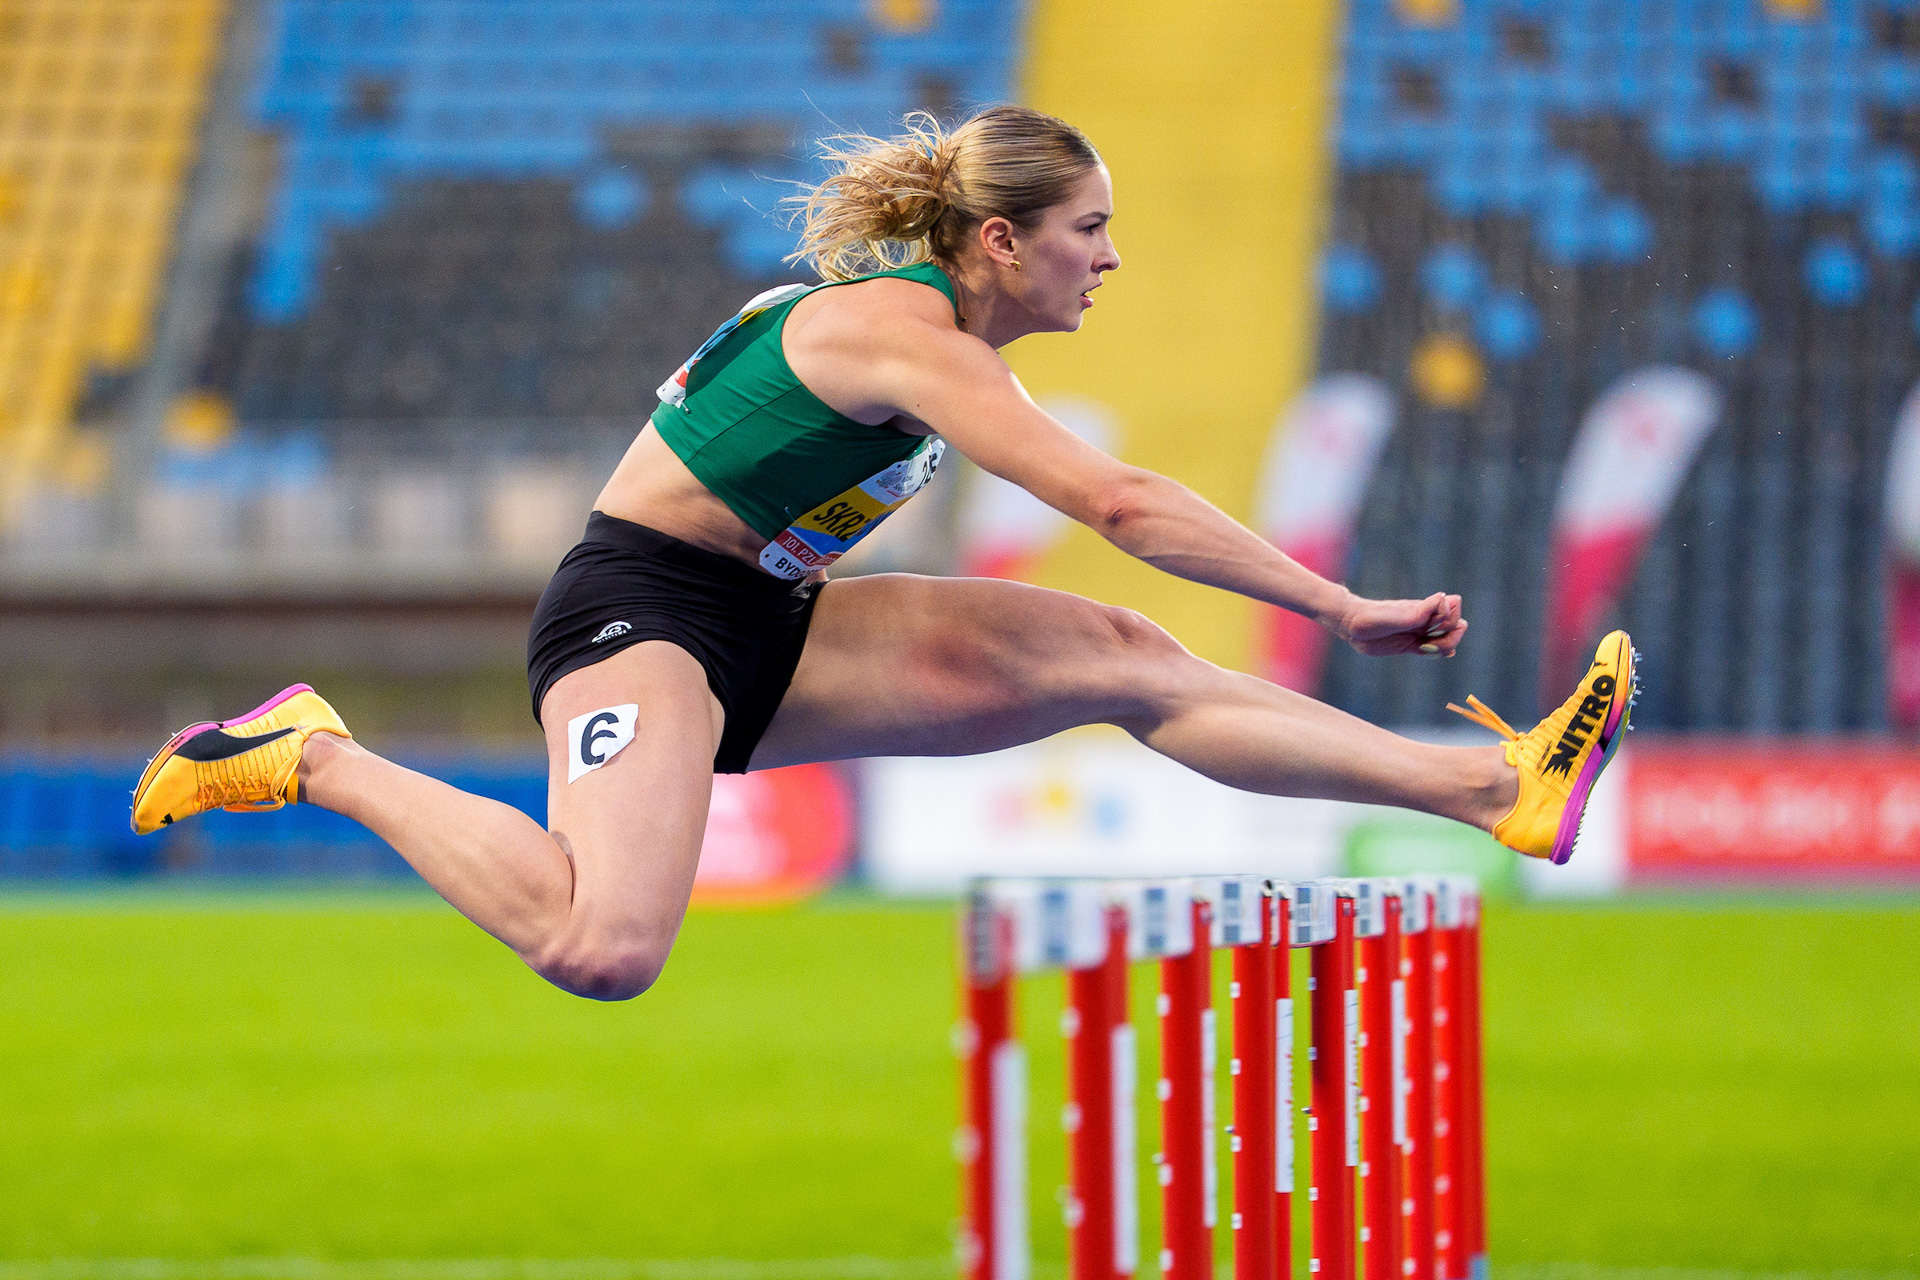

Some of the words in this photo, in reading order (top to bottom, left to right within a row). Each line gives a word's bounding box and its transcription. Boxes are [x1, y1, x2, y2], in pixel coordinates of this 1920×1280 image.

[797, 548, 818, 565] PZL
[580, 711, 619, 766] 6
[1541, 674, 1616, 781] NITRO
